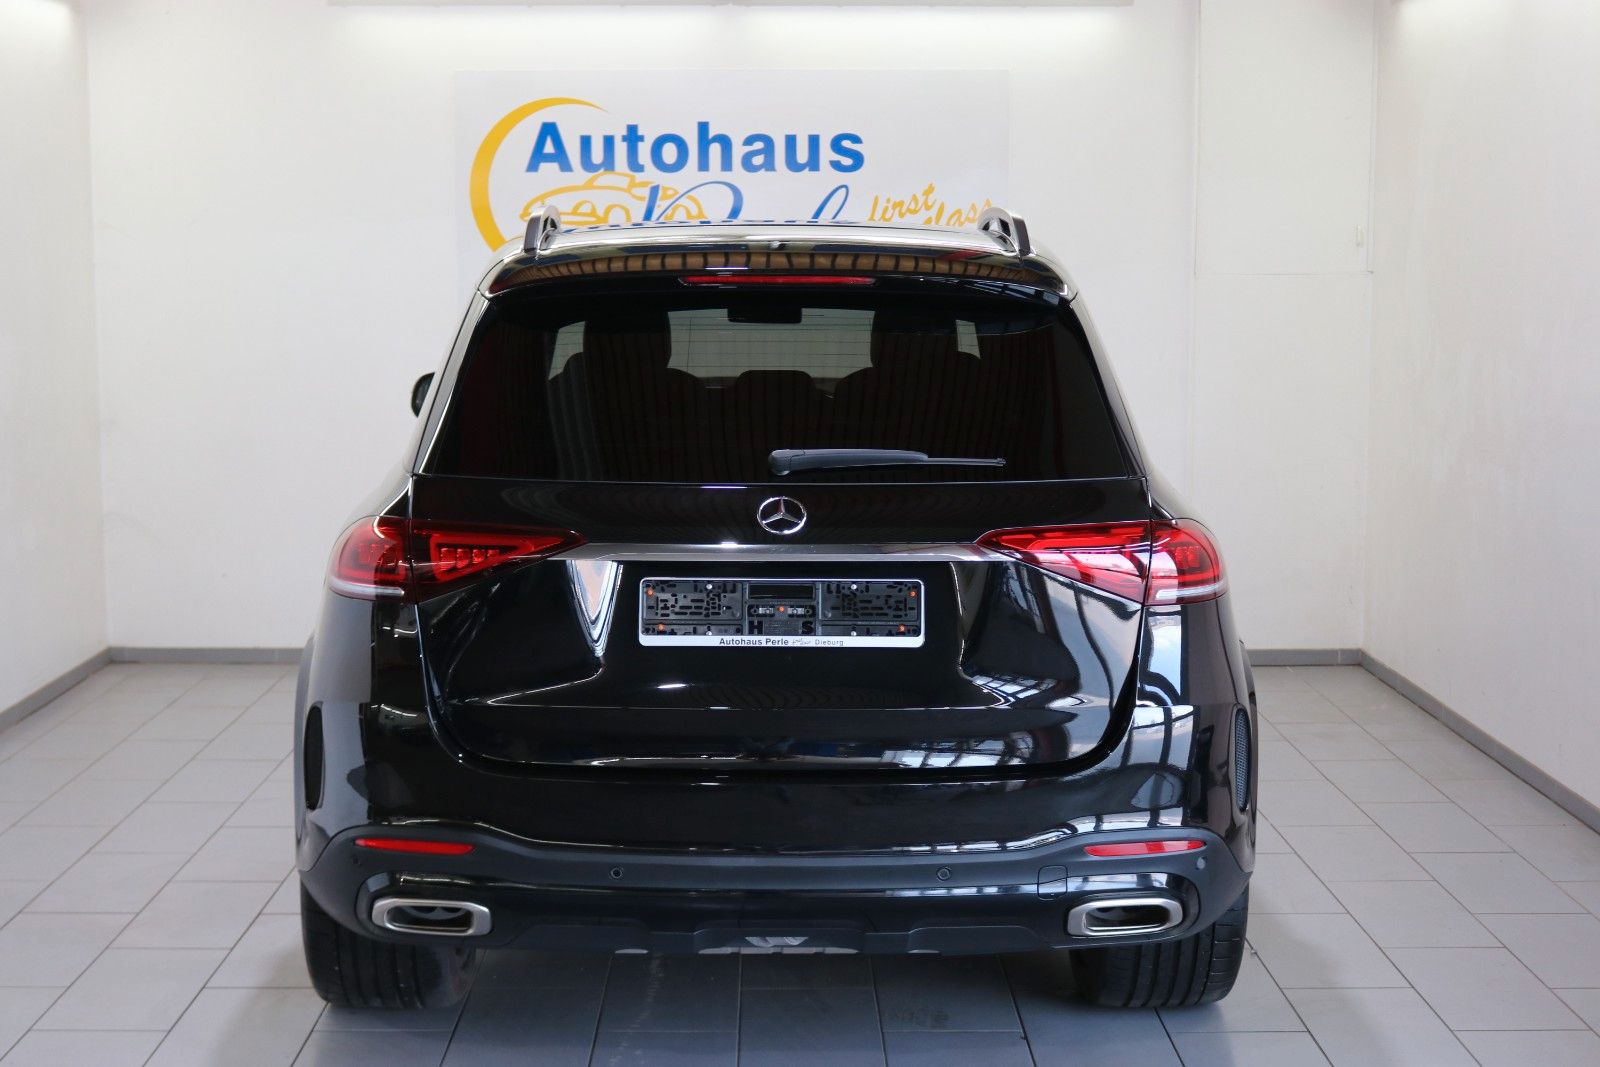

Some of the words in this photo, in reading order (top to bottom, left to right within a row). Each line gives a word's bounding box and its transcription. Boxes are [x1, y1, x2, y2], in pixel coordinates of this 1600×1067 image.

[526, 121, 865, 174] Autohaus
[719, 637, 763, 646] Autohaus
[765, 637, 789, 646] Perle
